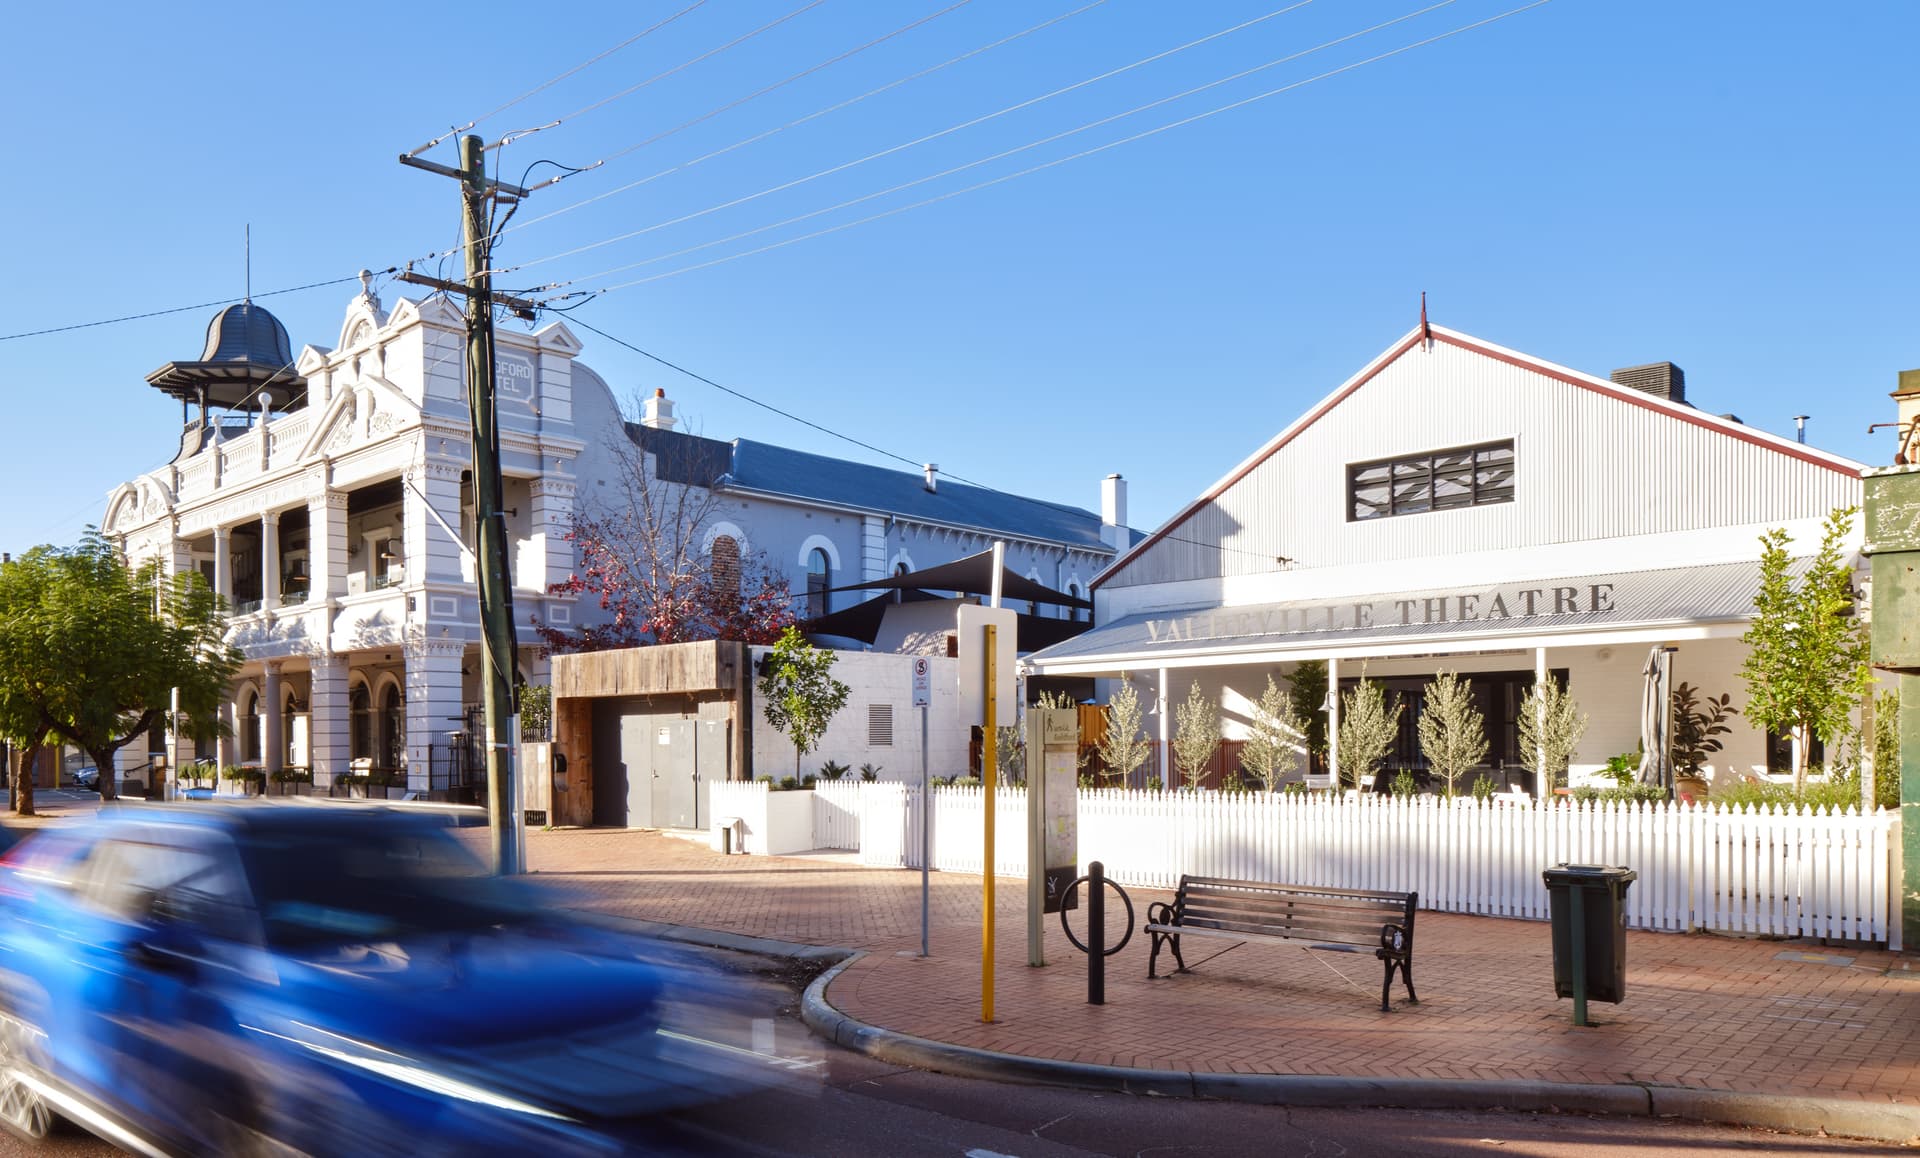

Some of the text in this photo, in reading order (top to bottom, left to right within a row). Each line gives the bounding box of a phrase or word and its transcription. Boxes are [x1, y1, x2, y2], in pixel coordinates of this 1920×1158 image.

[496, 360, 531, 379] DFORD
[496, 375, 519, 392] TEL
[1395, 583, 1615, 625] THEATRE
